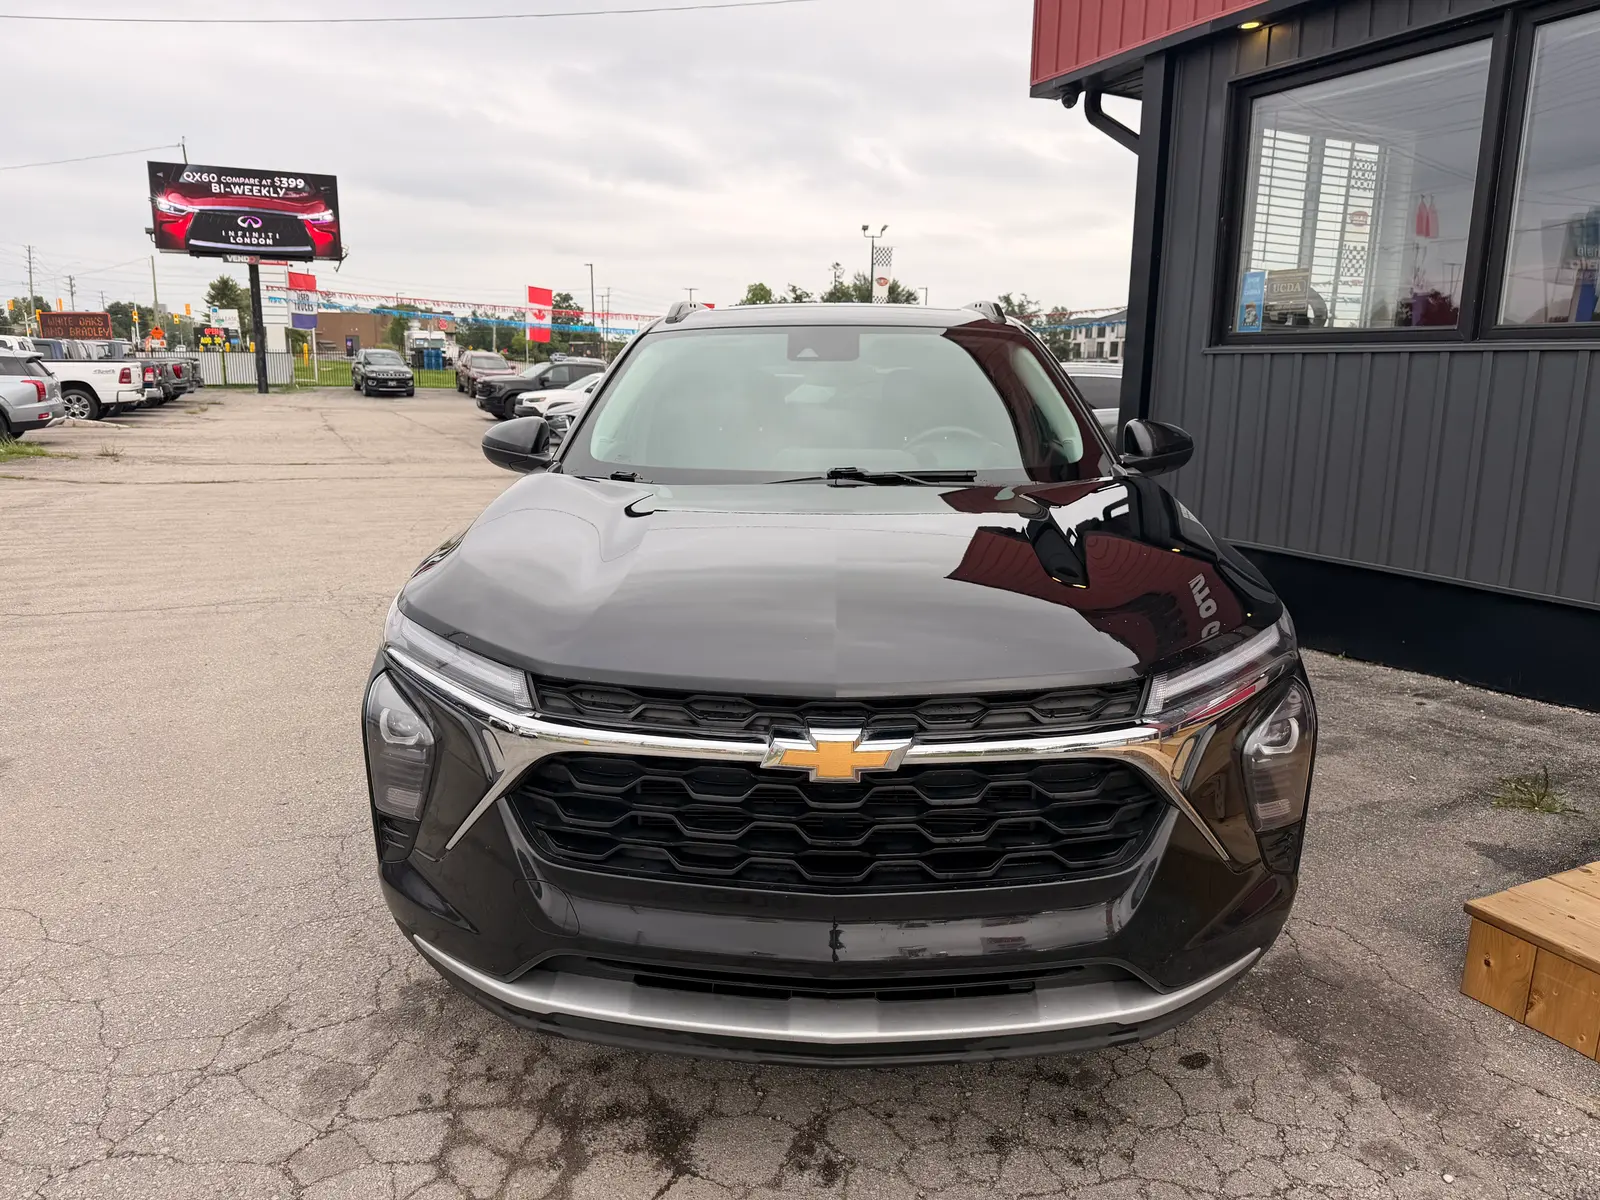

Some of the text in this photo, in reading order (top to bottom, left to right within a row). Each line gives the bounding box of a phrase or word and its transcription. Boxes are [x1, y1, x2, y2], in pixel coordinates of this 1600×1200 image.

[183, 171, 305, 189] QX60 COMPARE AT $399
[211, 183, 286, 198] BI-WEEKLY
[221, 230, 280, 239] INFINITI
[230, 236, 273, 245] LONDON
[1273, 282, 1301, 293] UCDA
[296, 292, 310, 301] USED
[294, 302, 314, 312] TRUCKS
[47, 316, 104, 327] WHITE OAKS
[45, 327, 110, 337] AND BRADLEY
